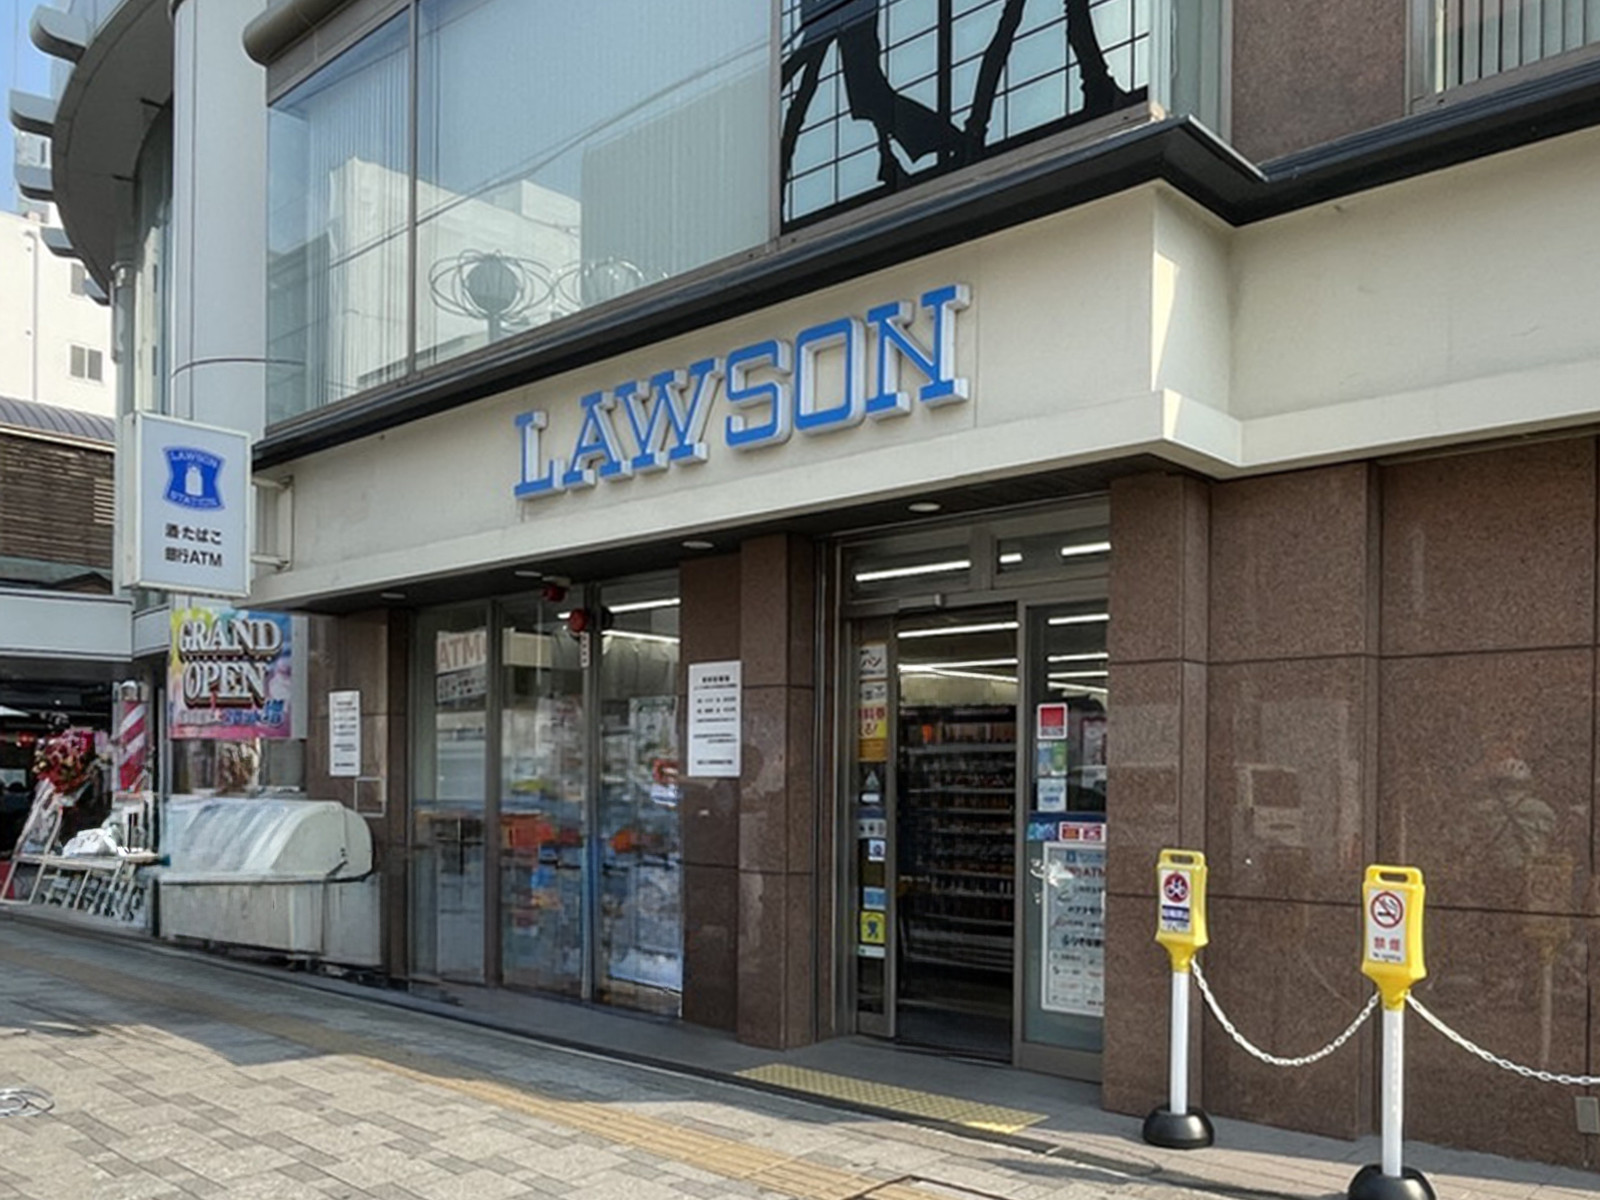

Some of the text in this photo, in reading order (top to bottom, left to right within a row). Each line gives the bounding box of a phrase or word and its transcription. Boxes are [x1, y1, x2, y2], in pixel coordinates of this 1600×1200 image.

[514, 284, 970, 498] LAWSON
[178, 617, 283, 655] GRAND
[184, 660, 268, 705] OPEN
